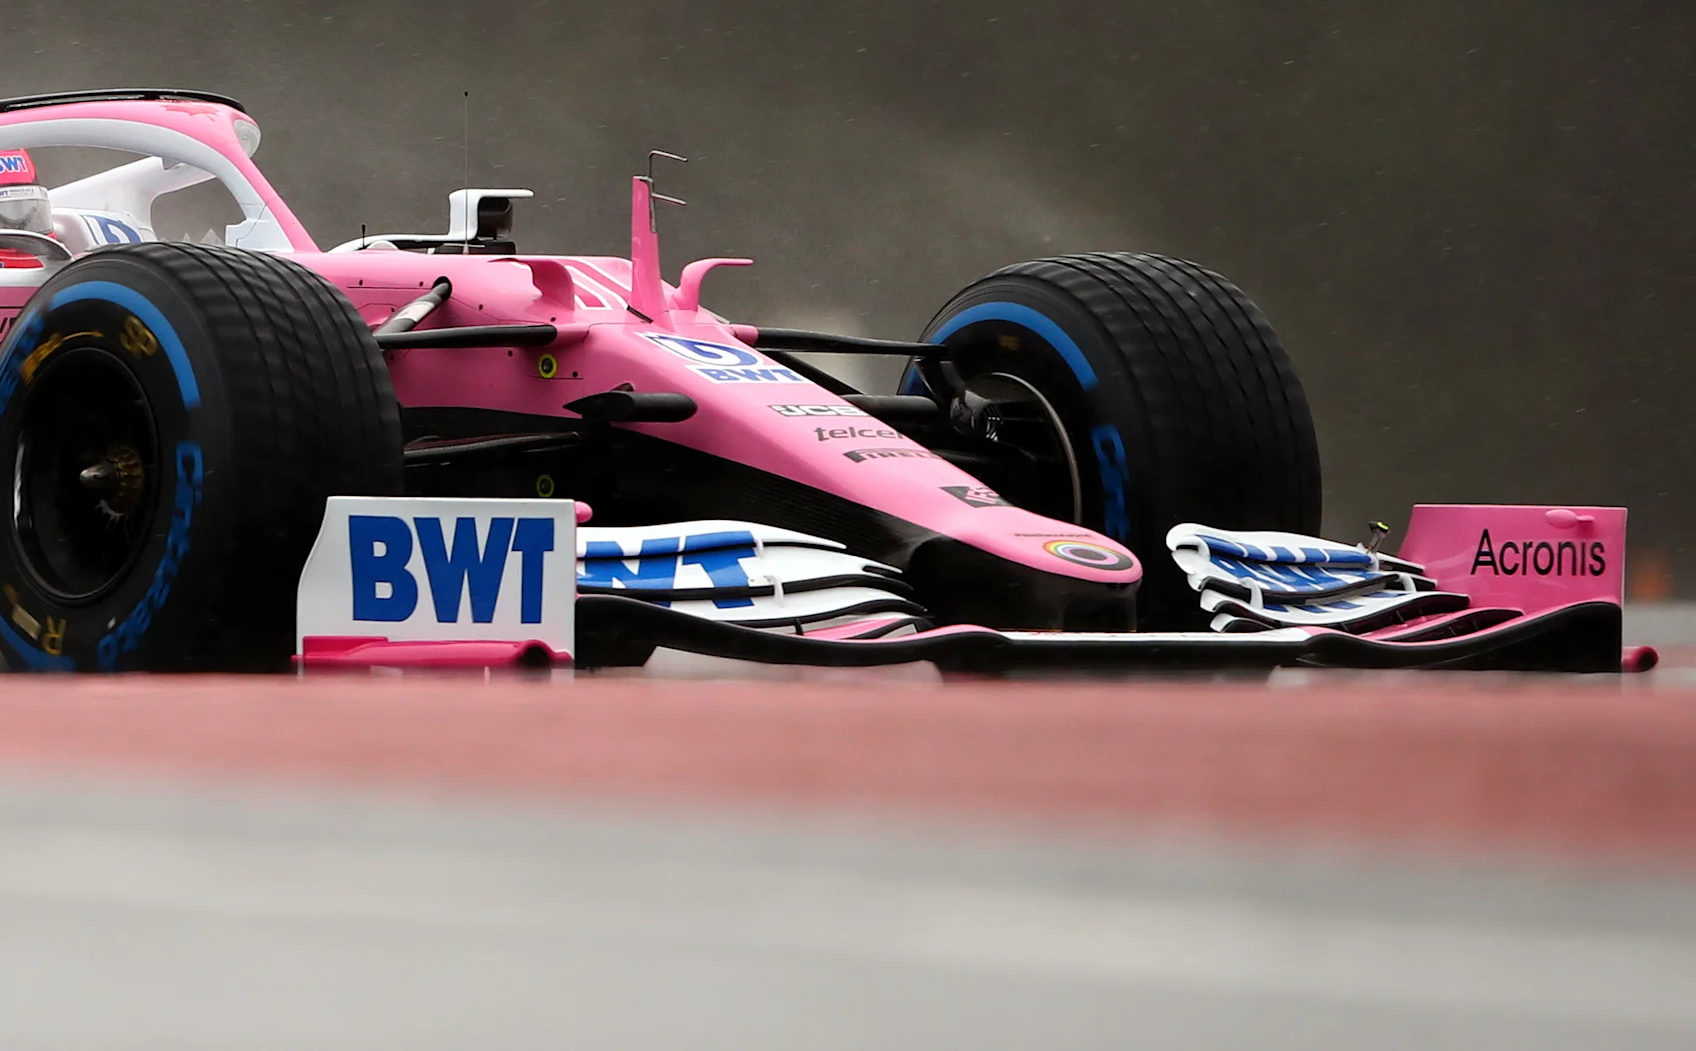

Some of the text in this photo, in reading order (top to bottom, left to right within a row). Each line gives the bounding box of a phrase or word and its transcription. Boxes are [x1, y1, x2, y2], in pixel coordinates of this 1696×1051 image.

[699, 367, 804, 382] BWT
[768, 405, 871, 417] JCB
[348, 515, 554, 624] BWT
[578, 531, 756, 608] WT
[1470, 528, 1606, 577] Acronis
